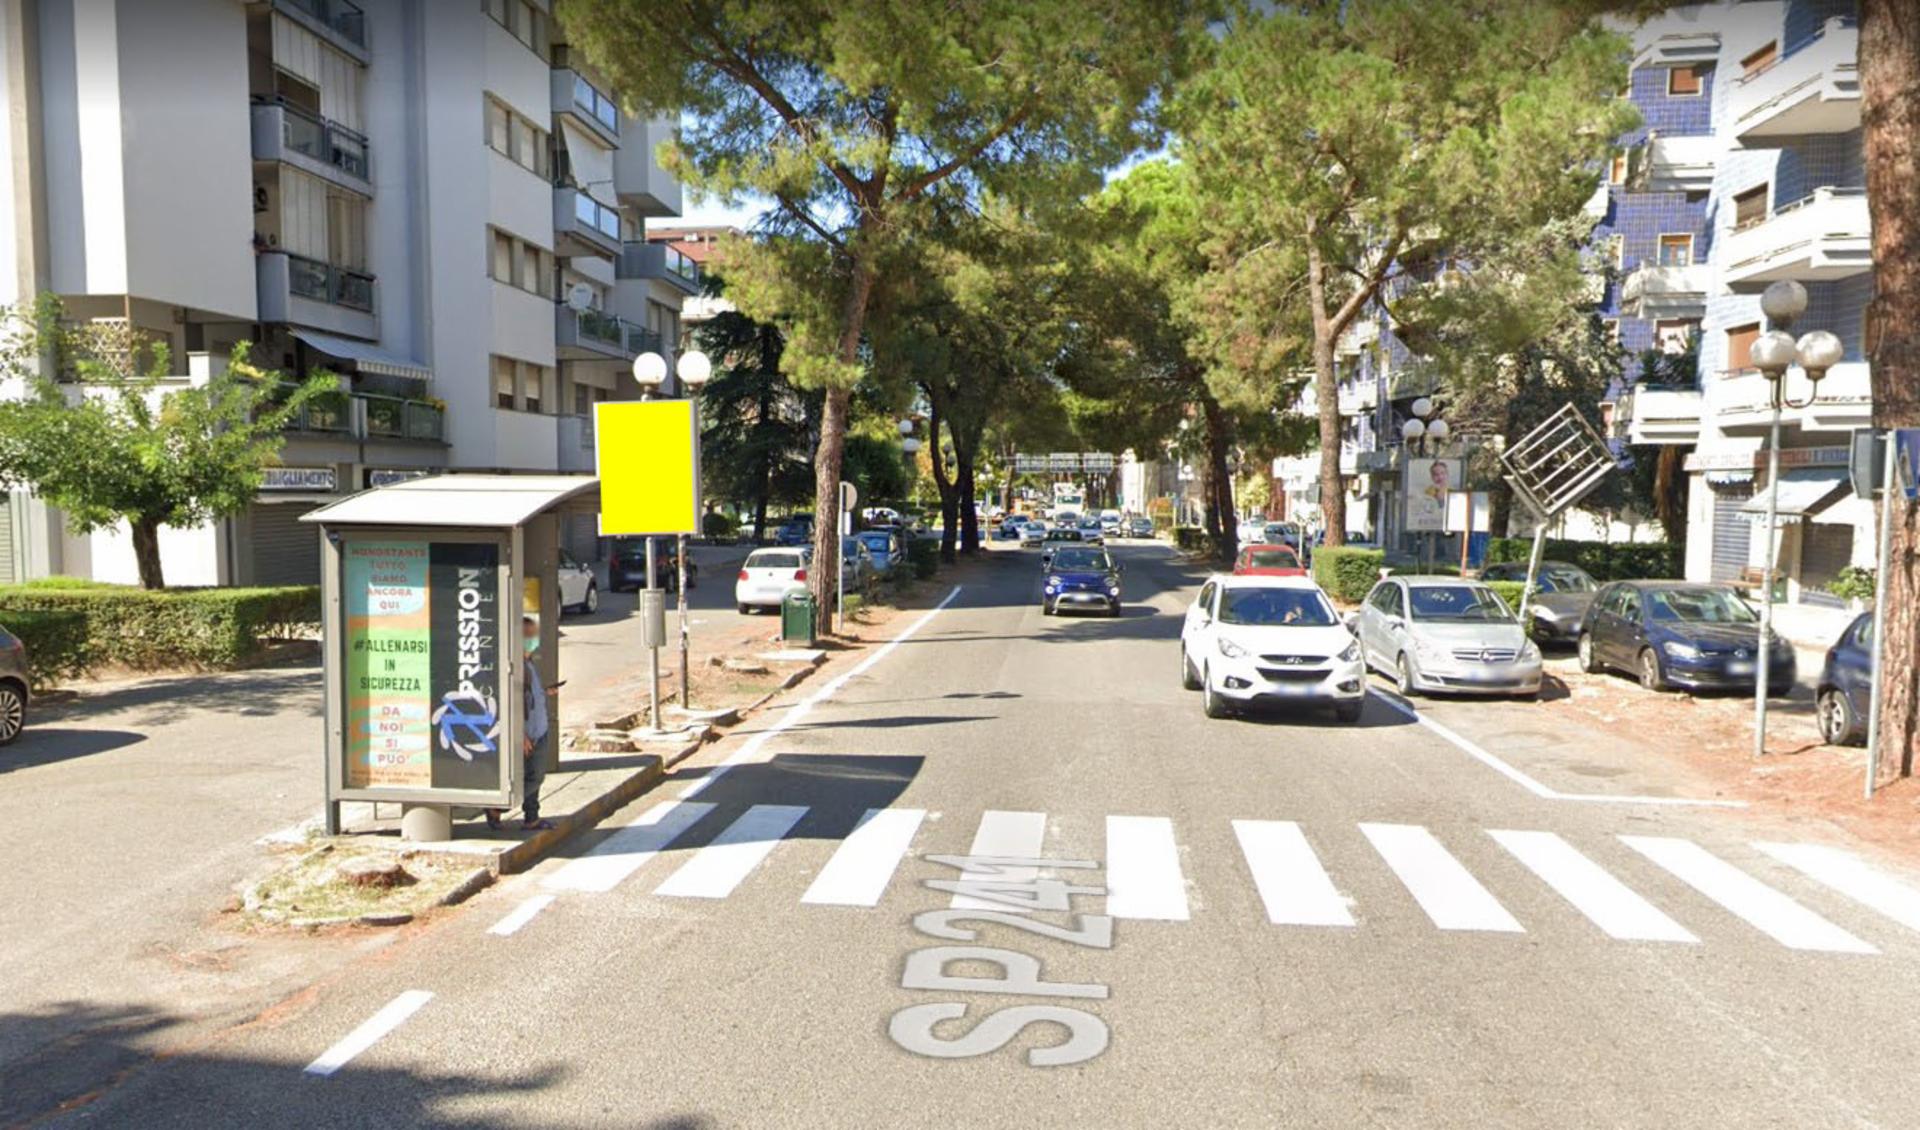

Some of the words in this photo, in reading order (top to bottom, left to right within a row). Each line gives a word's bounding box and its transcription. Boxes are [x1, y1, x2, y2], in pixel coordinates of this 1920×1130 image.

[366, 587, 413, 597] ANCORA
[379, 600, 400, 610] QUI
[354, 639, 428, 654] #ALLENARSI
[384, 659, 396, 672] IN
[360, 677, 421, 692] SICUREZZA
[382, 706, 401, 717] DA
[379, 722, 404, 733] NOI
[385, 738, 398, 749] SI
